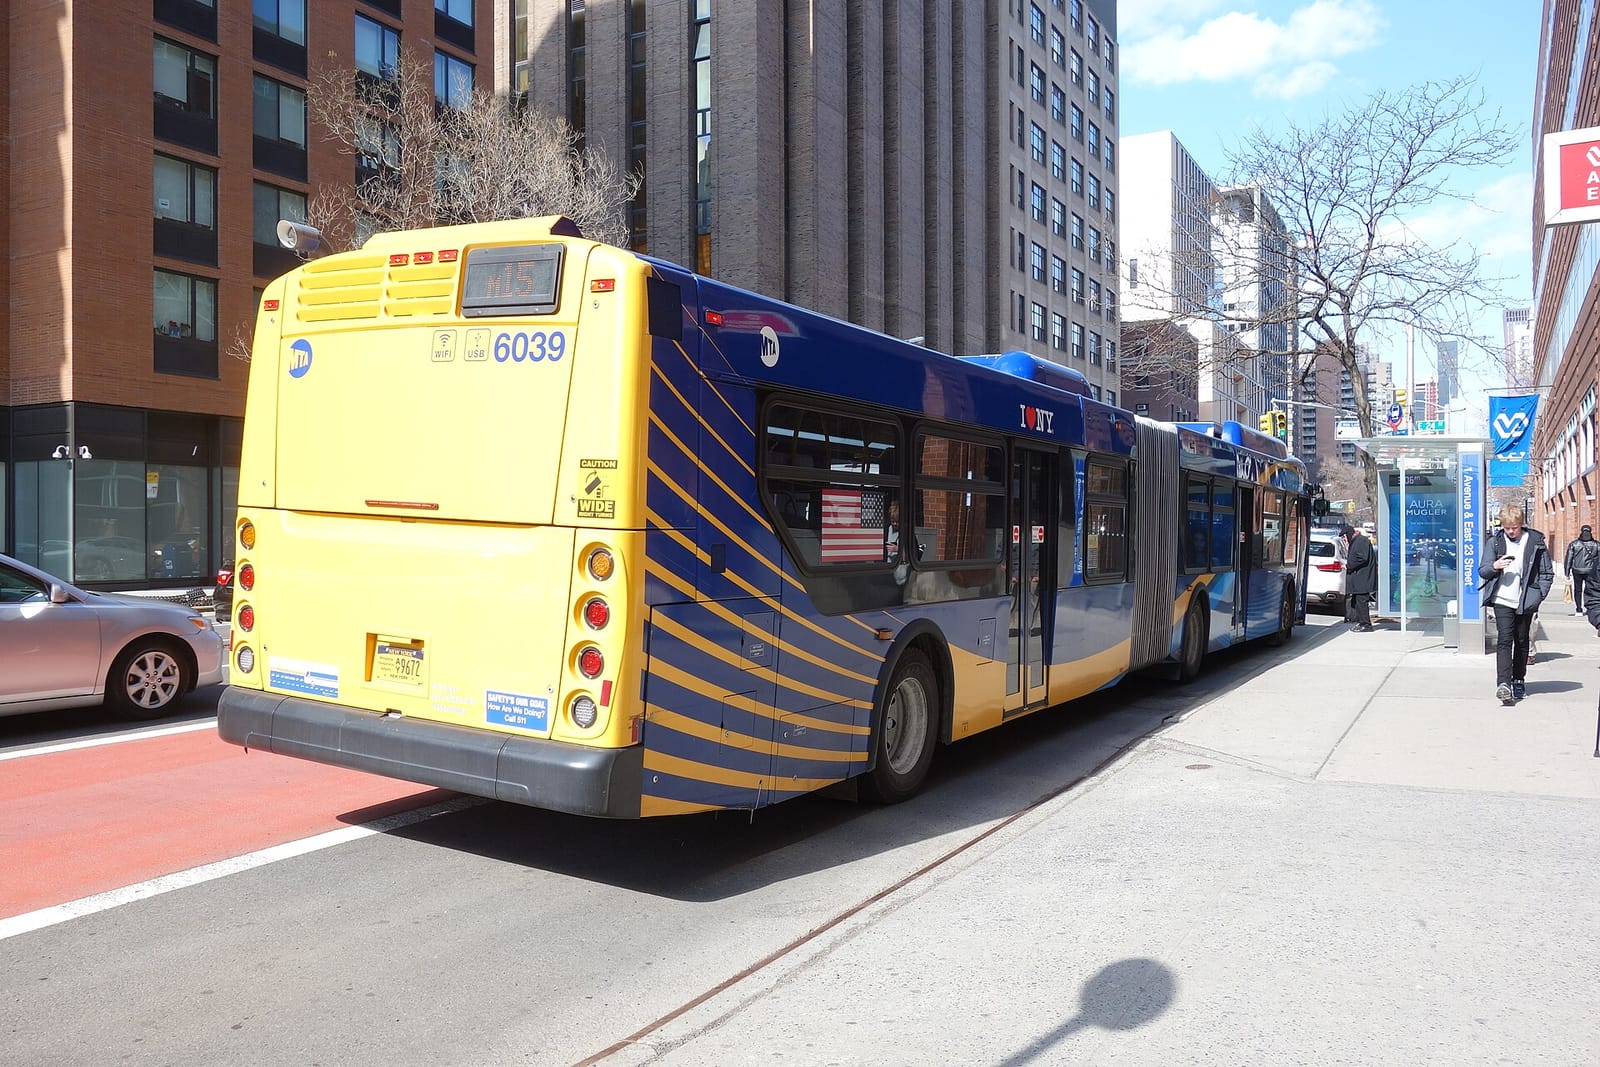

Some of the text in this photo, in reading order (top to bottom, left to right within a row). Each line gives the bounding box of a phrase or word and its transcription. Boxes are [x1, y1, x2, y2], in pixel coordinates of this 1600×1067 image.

[486, 261, 537, 298] M15
[434, 350, 452, 358] WIFI
[467, 349, 485, 358] USB
[493, 331, 566, 362] 6039
[1019, 404, 1054, 433] I NY
[581, 460, 616, 468] CAUTION
[1463, 474, 1474, 510] Avenue
[579, 500, 614, 513] WIDE
[1409, 499, 1443, 509] AURA
[1463, 521, 1474, 542] East
[1463, 544, 1474, 556] 23
[1463, 558, 1474, 586] Street
[401, 658, 420, 677] 9672
[487, 693, 546, 709] SAFETY'S OUR GOAL
[487, 702, 545, 719] How Are We Doing?
[504, 715, 527, 725] Call 511
